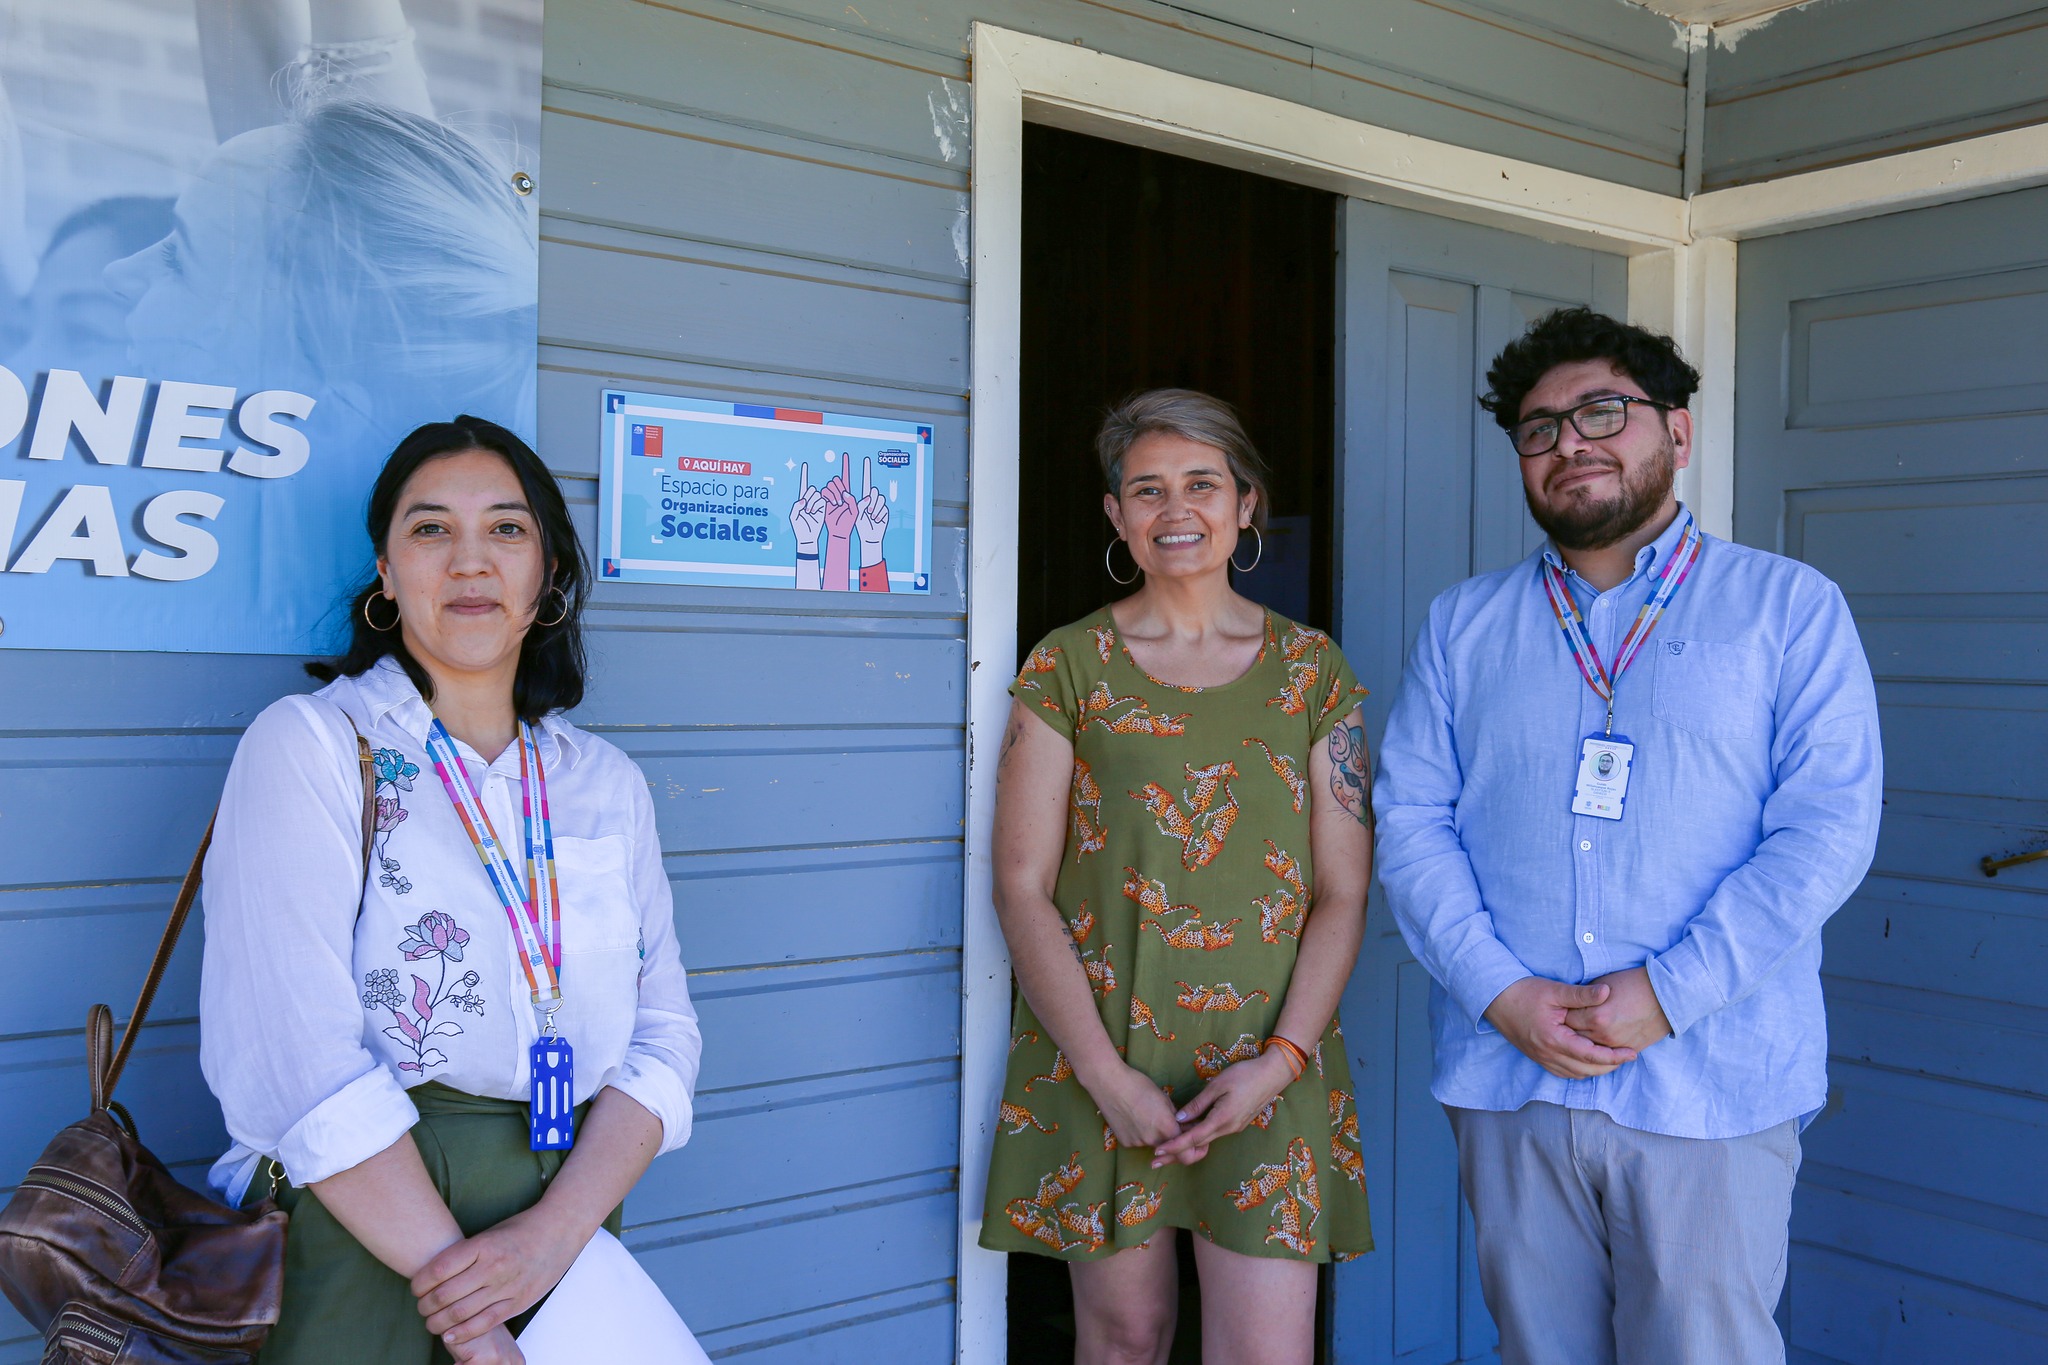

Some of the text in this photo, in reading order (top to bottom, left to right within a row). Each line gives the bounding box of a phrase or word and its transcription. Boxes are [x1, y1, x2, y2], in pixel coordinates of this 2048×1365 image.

[0, 364, 317, 479] NES
[692, 459, 746, 474] AQUÍ HAY
[878, 456, 909, 464] SOCIALES
[661, 474, 769, 501] Espacio para
[661, 498, 769, 517] Organizaciones
[660, 514, 768, 543] Sociales
